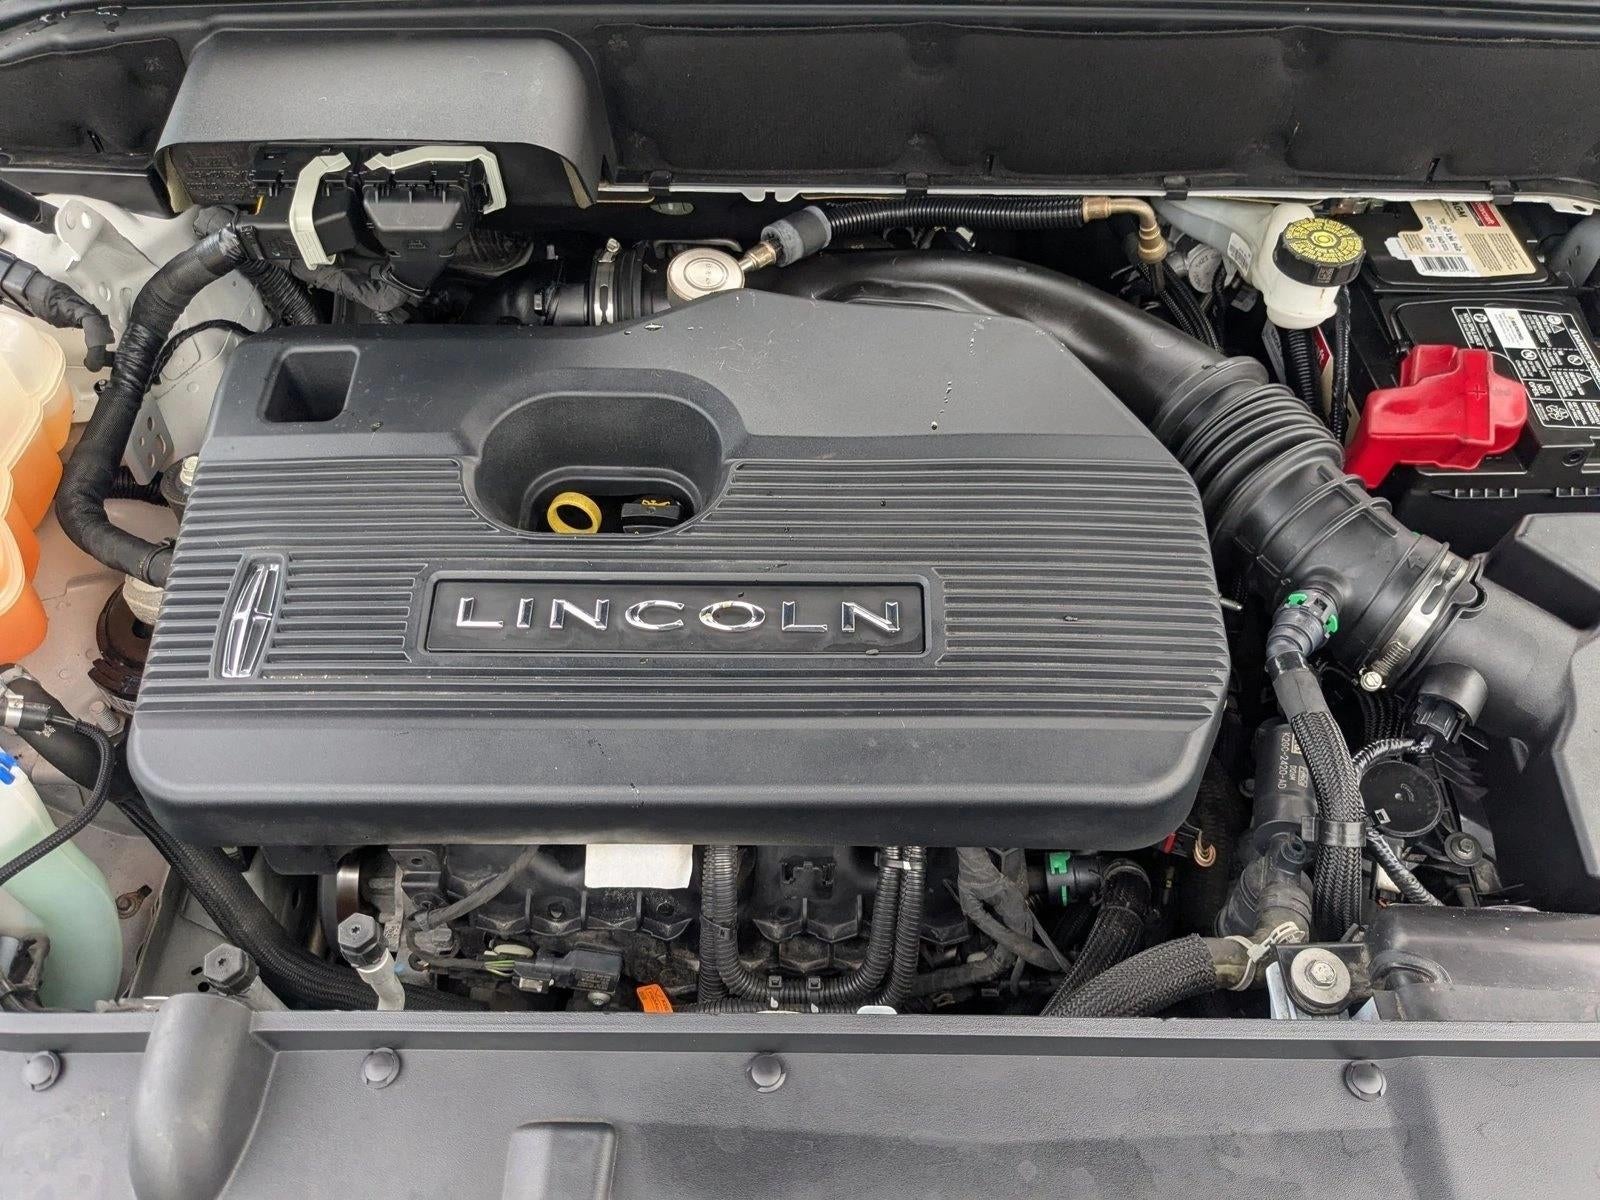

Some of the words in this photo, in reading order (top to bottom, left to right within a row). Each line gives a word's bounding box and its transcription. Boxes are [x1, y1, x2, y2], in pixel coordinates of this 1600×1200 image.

[1536, 383, 1547, 395] NOT
[1544, 385, 1554, 395] DO
[456, 597, 902, 633] LINCOLN
